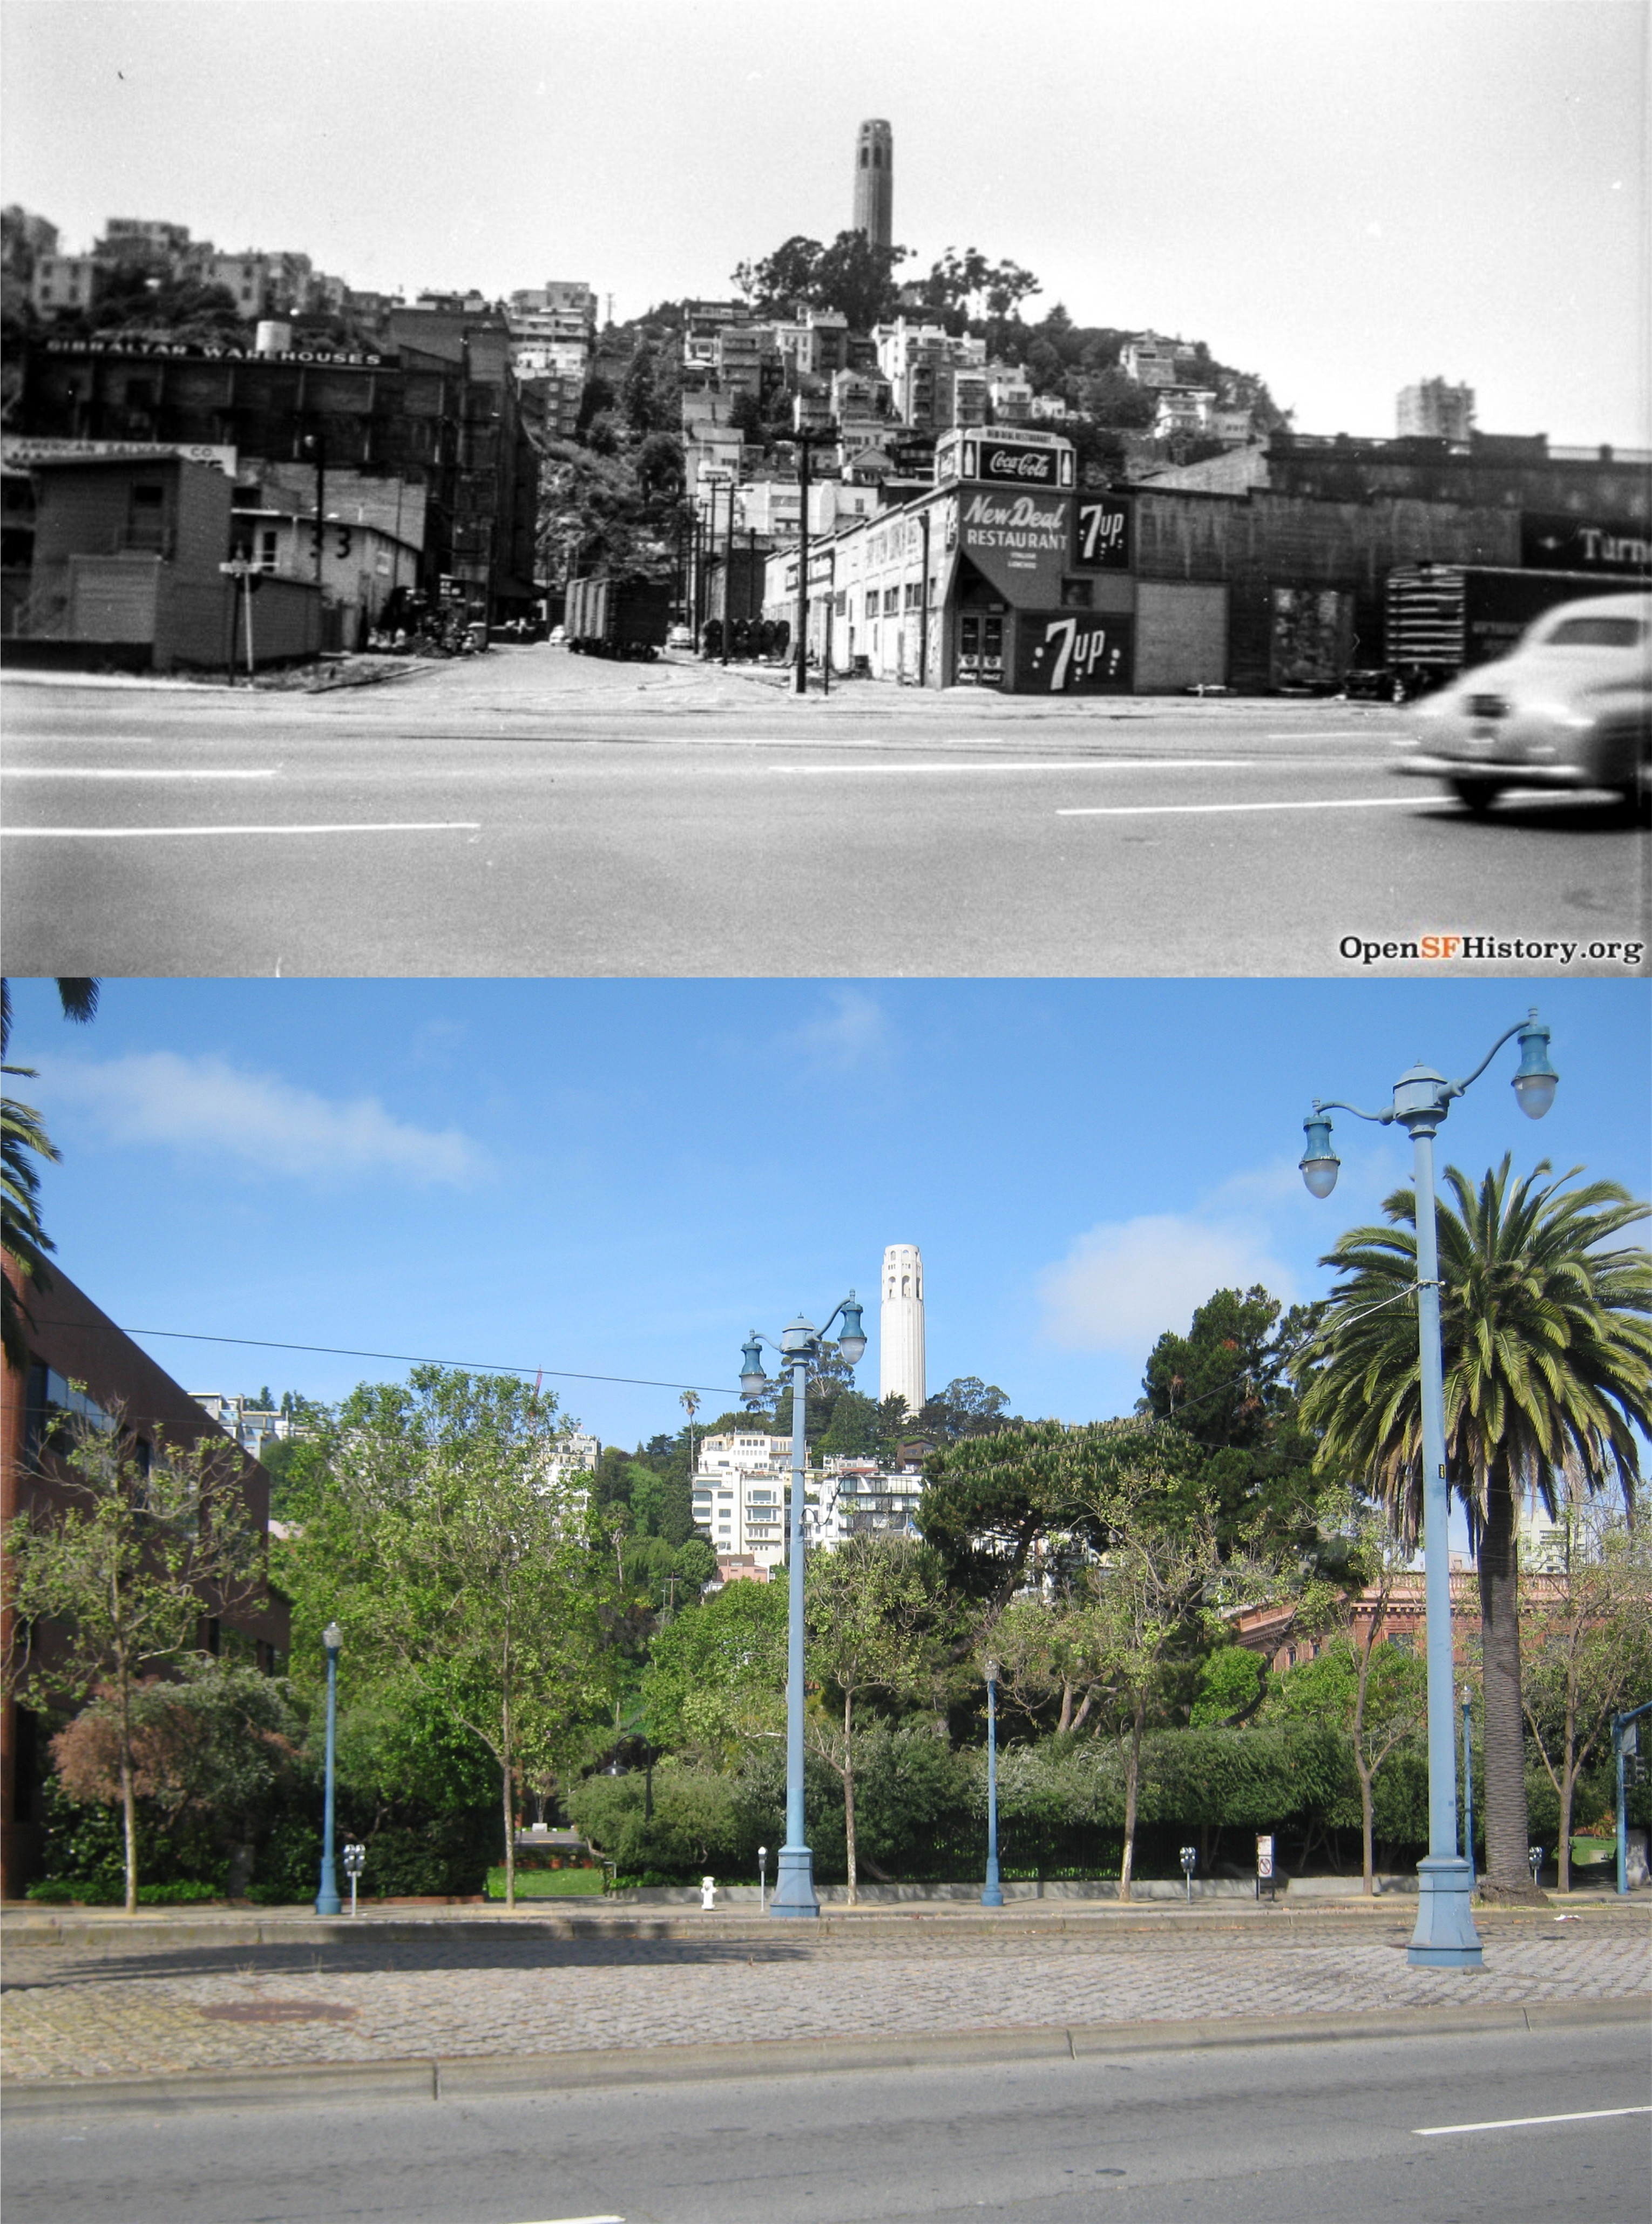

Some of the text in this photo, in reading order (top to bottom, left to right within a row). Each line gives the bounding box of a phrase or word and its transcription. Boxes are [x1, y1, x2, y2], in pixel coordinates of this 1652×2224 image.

[203, 346, 382, 365] WAREHOUSES
[990, 450, 1052, 478] Coca-Cola
[963, 494, 1067, 528] New Deal
[967, 528, 1068, 550] RESTAURANT
[1579, 527, 1652, 563] Turn
